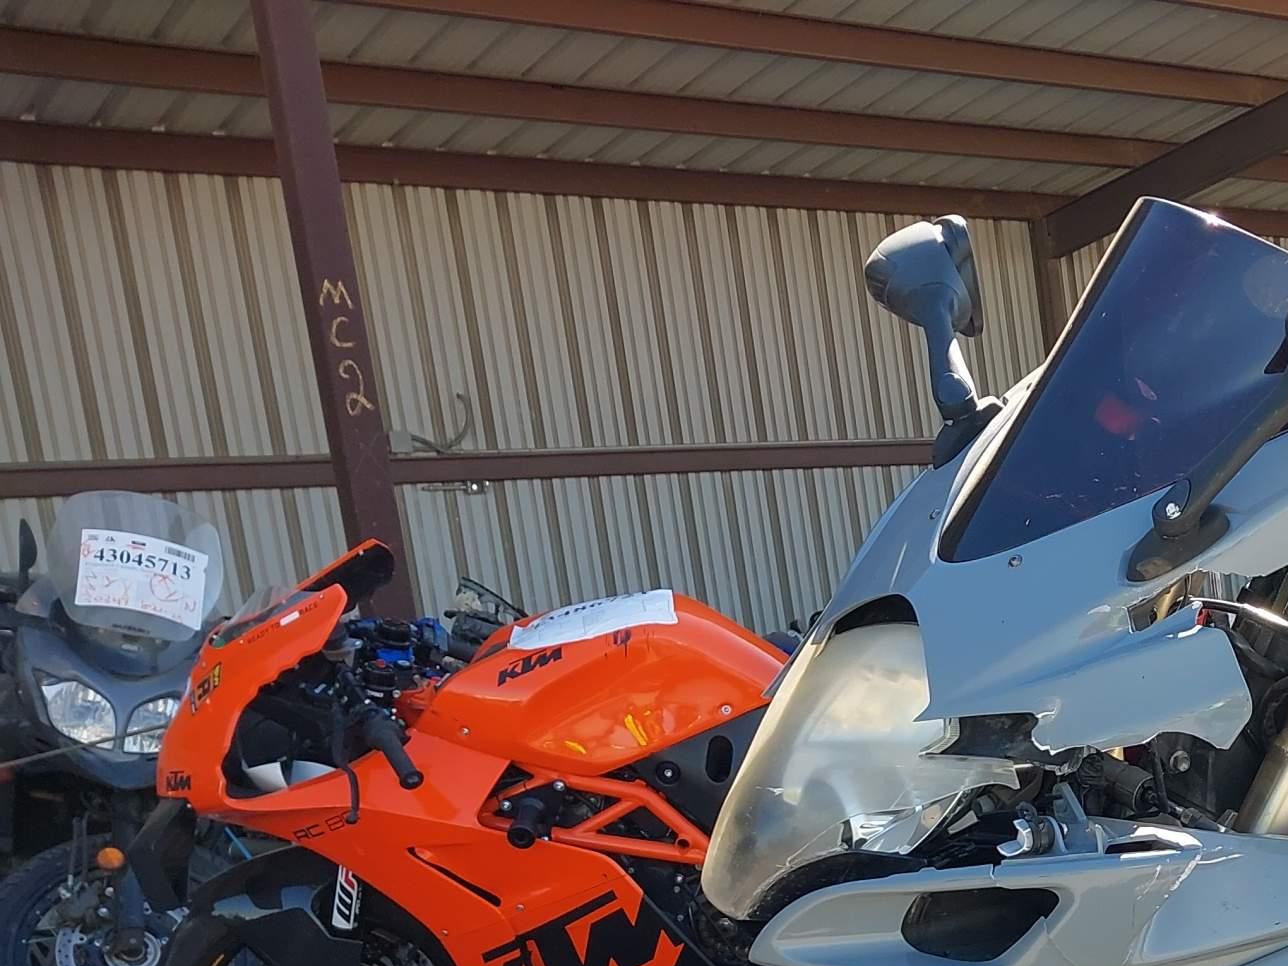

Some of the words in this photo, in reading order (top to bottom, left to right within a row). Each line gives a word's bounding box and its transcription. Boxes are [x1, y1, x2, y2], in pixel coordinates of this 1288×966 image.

[319, 278, 375, 417] MC2
[93, 547, 192, 580] 43045713
[498, 647, 562, 686] KTM
[166, 770, 191, 791] KTM
[293, 823, 325, 841] RC
